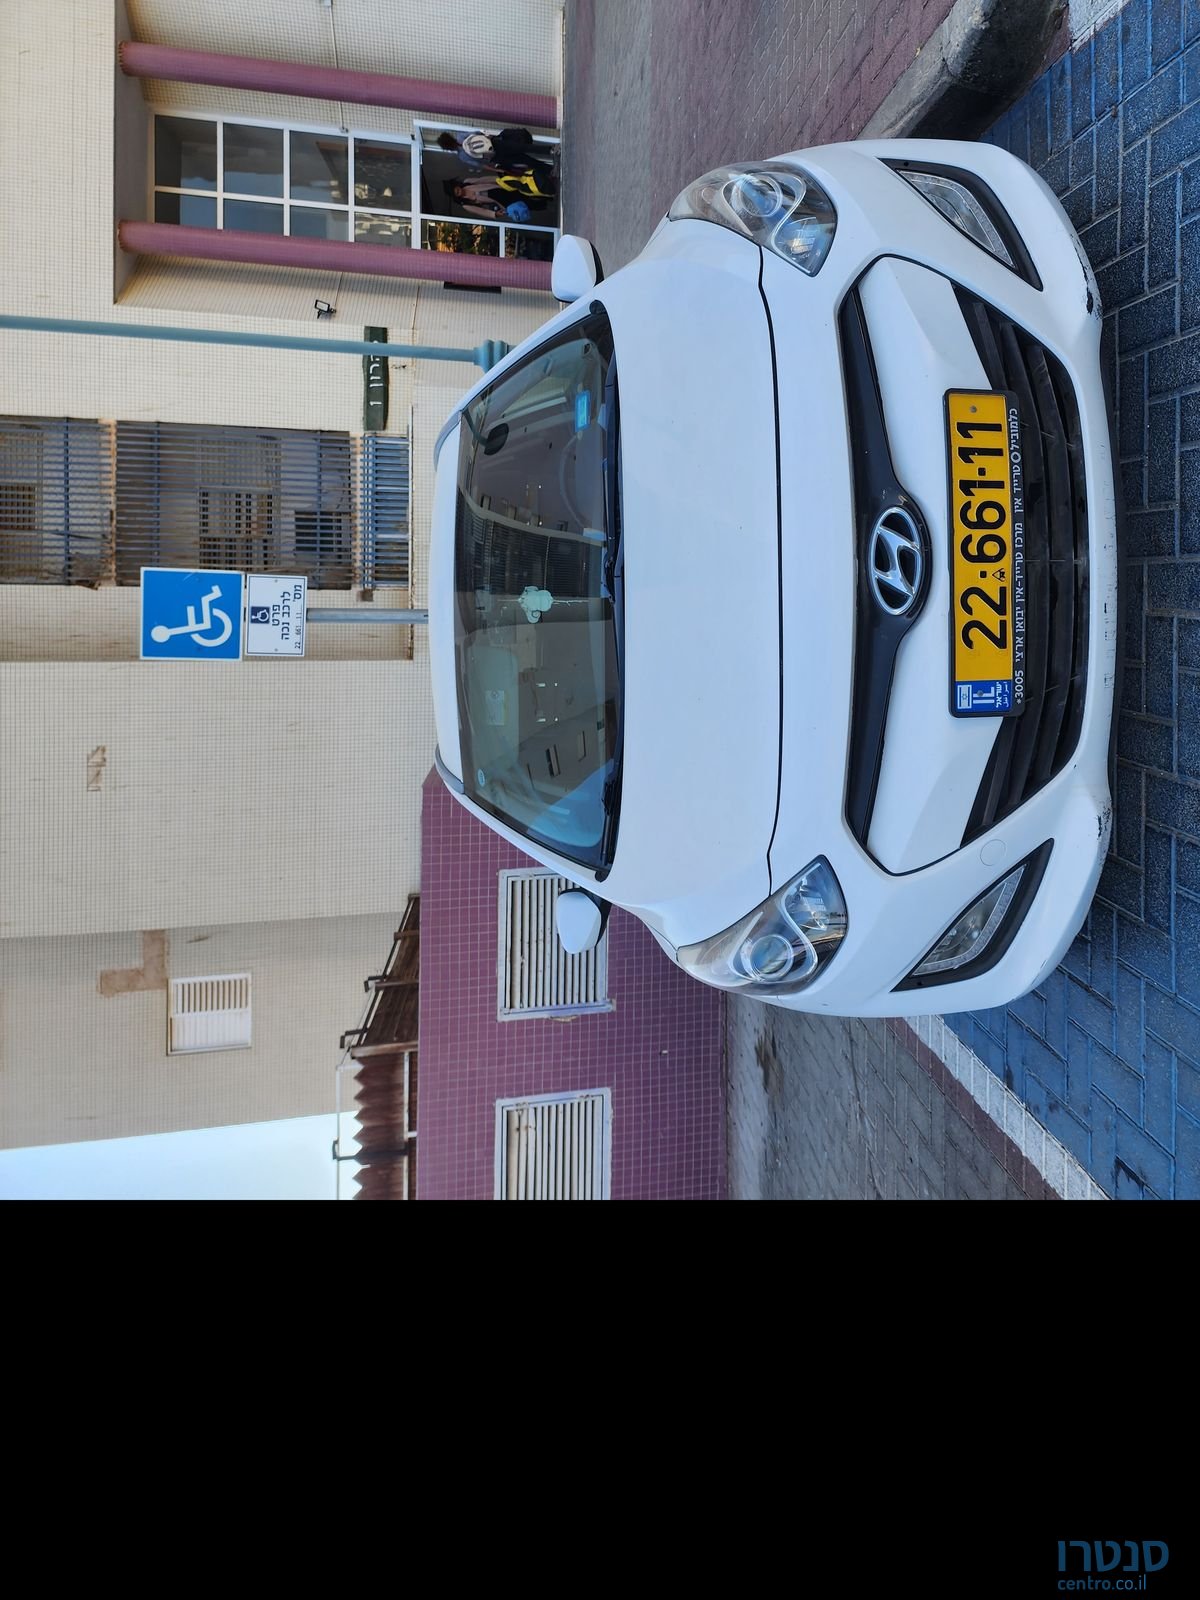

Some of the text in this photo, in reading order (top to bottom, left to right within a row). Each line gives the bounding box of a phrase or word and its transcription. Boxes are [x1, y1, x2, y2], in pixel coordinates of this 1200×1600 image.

[370, 340, 384, 388] הרון
[1008, 408, 1020, 450] כלמוביל
[1012, 464, 1022, 494] טרייד
[1014, 498, 1024, 513] אין
[1014, 522, 1024, 548] מרכז
[292, 584, 302, 602] מס'
[272, 604, 280, 626] פרט
[280, 591, 291, 640] לרכב נכה
[1014, 606, 1026, 632] יבואן
[1014, 636, 1024, 662] ארצי
[972, 686, 995, 704] IL
